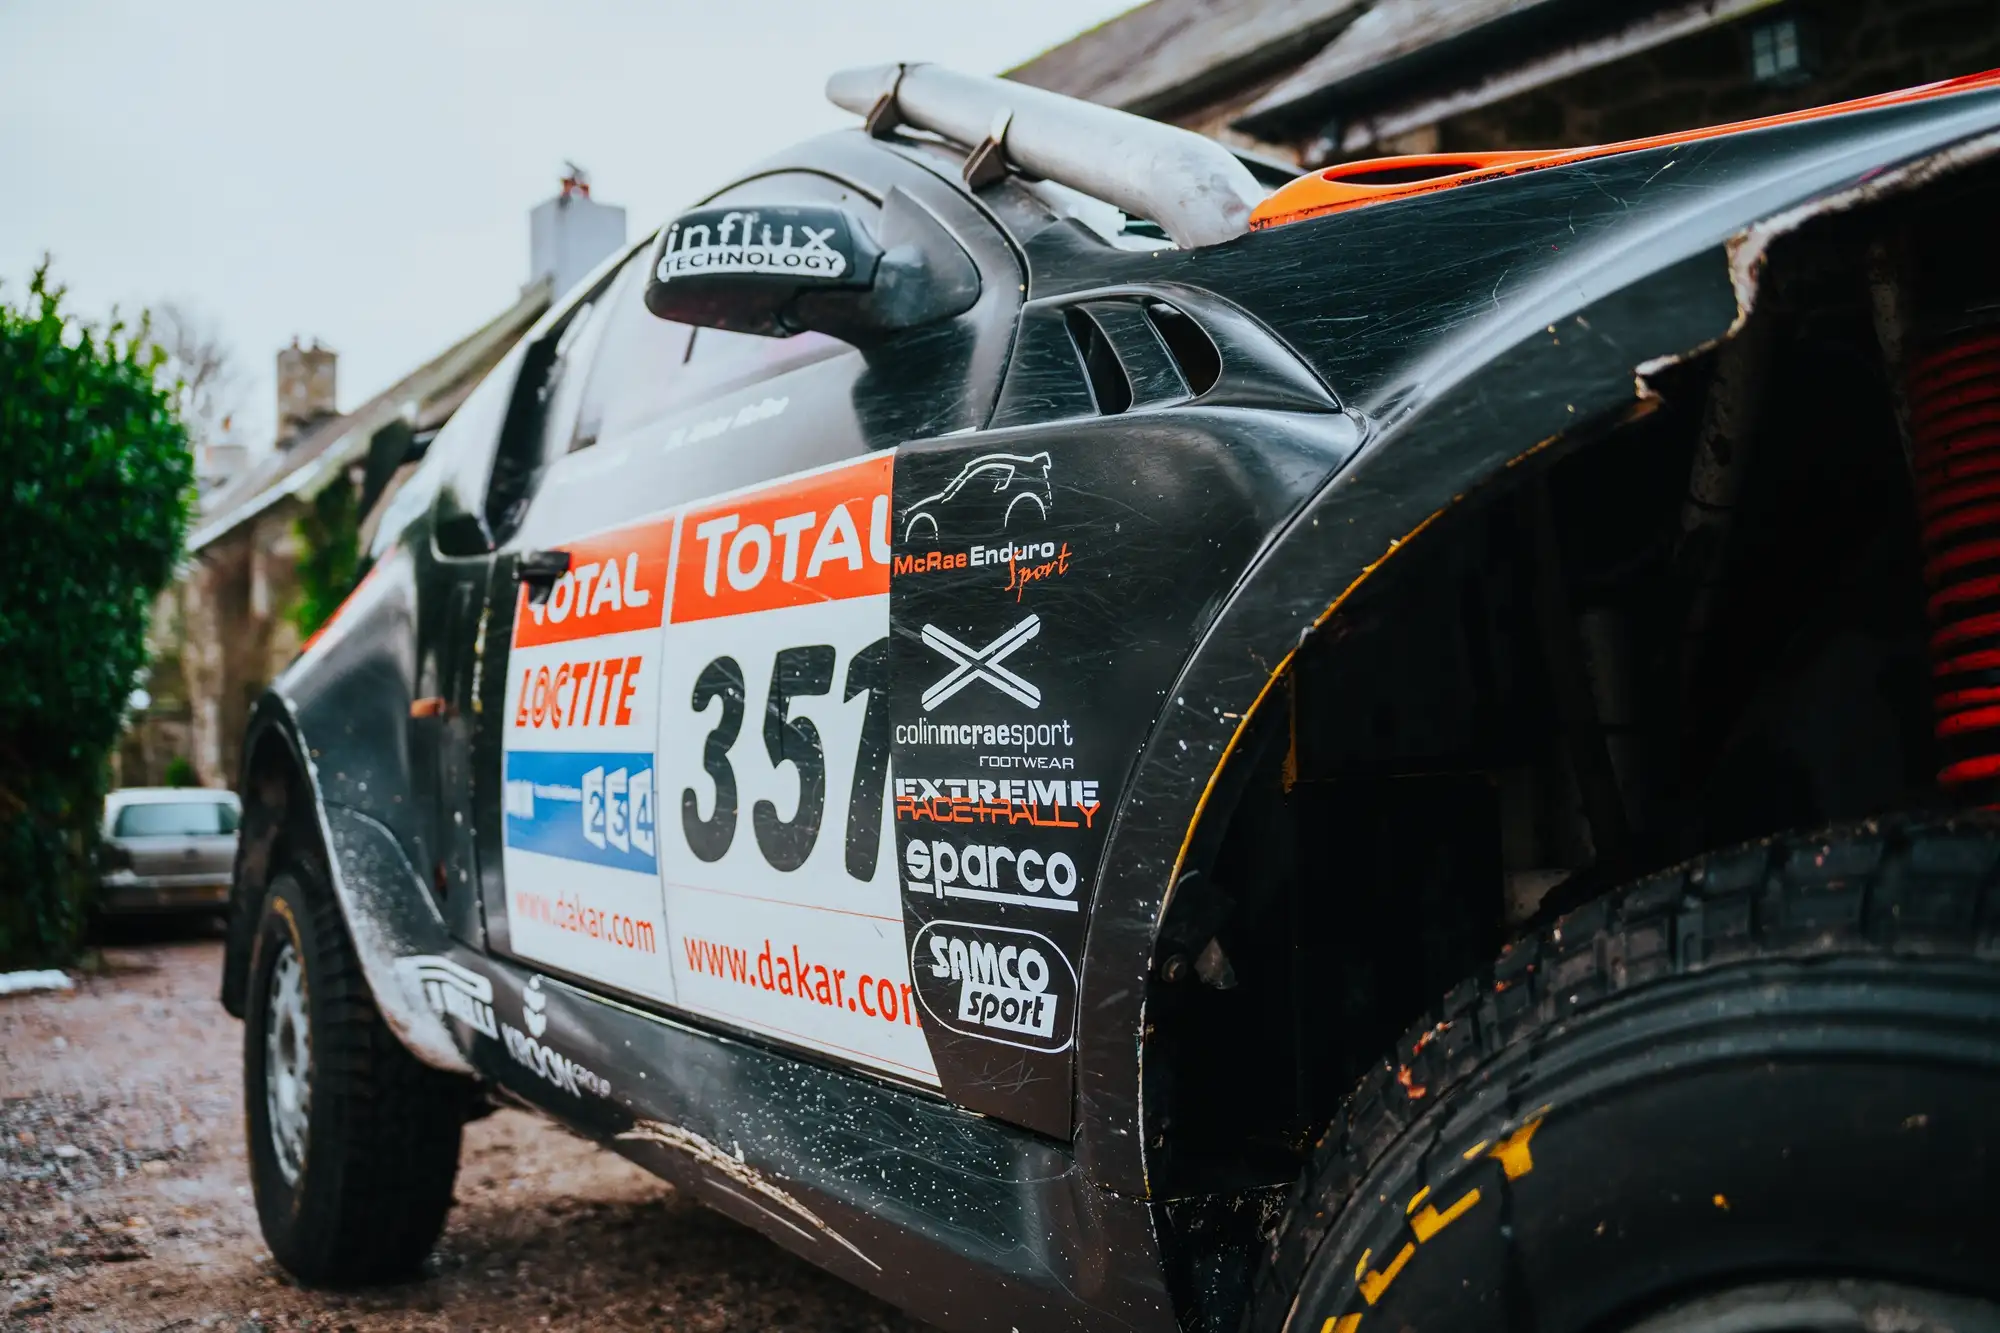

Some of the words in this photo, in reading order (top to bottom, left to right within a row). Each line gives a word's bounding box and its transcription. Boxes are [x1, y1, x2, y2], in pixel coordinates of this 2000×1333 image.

[665, 211, 836, 255] influx
[664, 251, 838, 274] TECHNOLOGY
[1004, 542, 1072, 603] Sport
[515, 655, 643, 730] LOCTITE
[682, 636, 891, 883] 351
[979, 755, 1074, 770] FOOTWEAR
[896, 778, 1100, 807] EXTREME
[906, 838, 1077, 899] sparco
[929, 935, 1049, 993] SAMCO
[967, 991, 1044, 1029] sport
